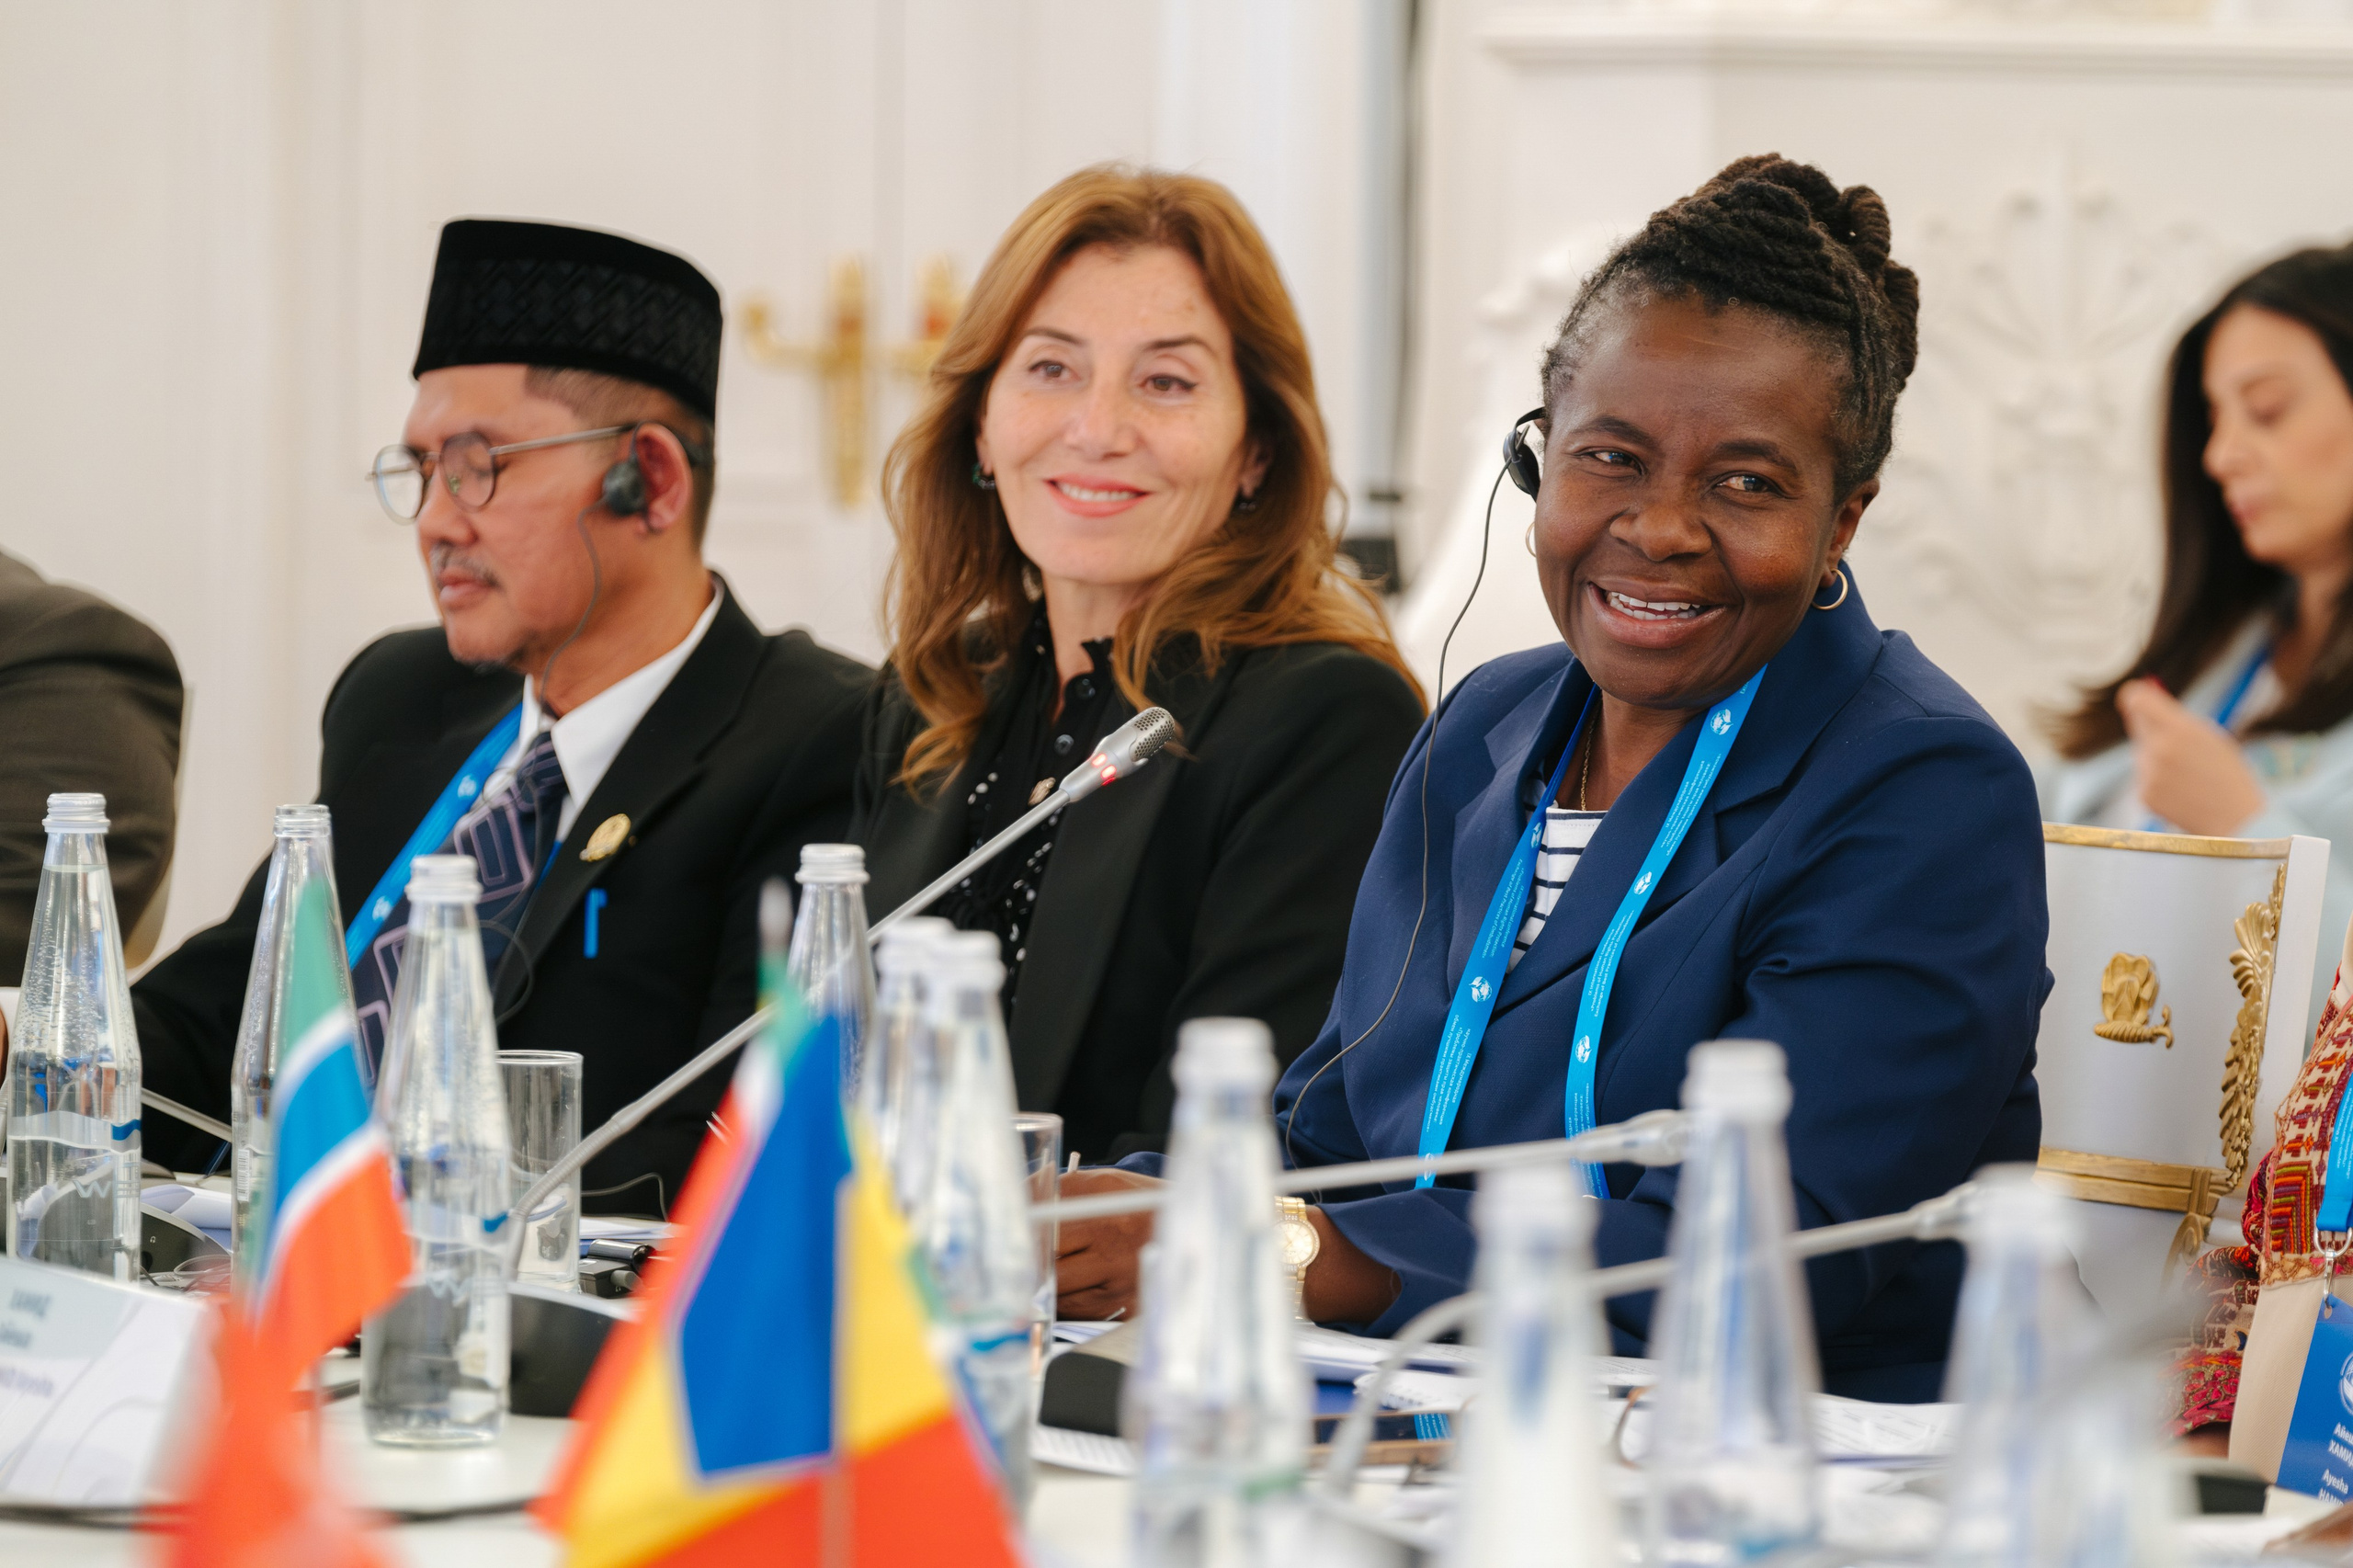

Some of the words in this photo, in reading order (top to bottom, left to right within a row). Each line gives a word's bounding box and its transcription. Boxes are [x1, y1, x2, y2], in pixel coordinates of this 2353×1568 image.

[1510, 858, 1523, 881] Exchange
[1495, 898, 1506, 920] Practices
[1505, 898, 1514, 916] Human
[1498, 916, 1507, 931] Rights
[1501, 922, 1512, 948] conference
[1598, 957, 1608, 977] Human
[1604, 940, 1614, 958] Rights
[1589, 955, 1602, 990] International
[1594, 992, 1604, 1017] Exchange
[1605, 949, 1617, 972] Practices
[1449, 1014, 1460, 1032] обмен
[1442, 1031, 1453, 1058] лучшими
[1449, 1028, 1472, 1086] научно-практическая
[1434, 1058, 1446, 1092] практиками
[1443, 1059, 1452, 1081] защиты
[1451, 1059, 1470, 1103] Международная
[1438, 1087, 1452, 1125] конференция
[2336, 1087, 2353, 1135] Международная
[2322, 1469, 2348, 1494] Ayesha
